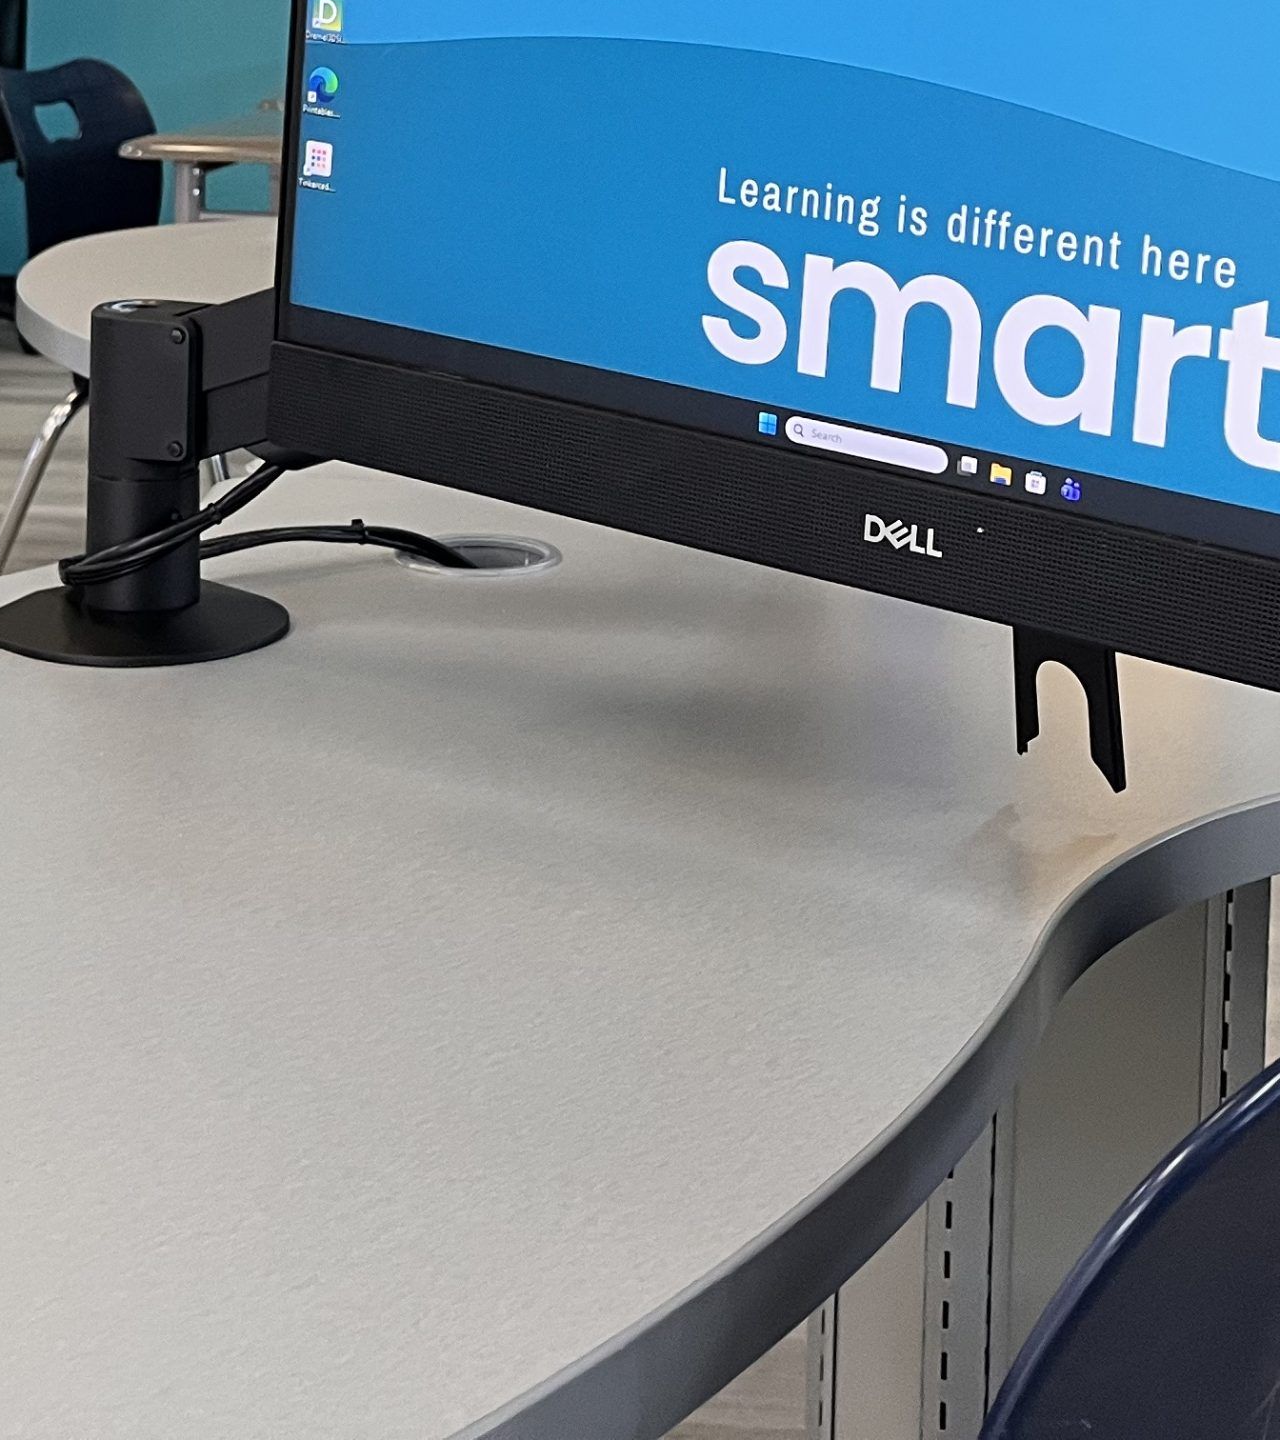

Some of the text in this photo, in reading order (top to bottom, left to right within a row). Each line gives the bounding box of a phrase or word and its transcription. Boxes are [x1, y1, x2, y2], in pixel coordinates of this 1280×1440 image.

[717, 167, 1237, 289] Learning is different here
[811, 429, 843, 444] Search
[863, 513, 943, 559] DELL
